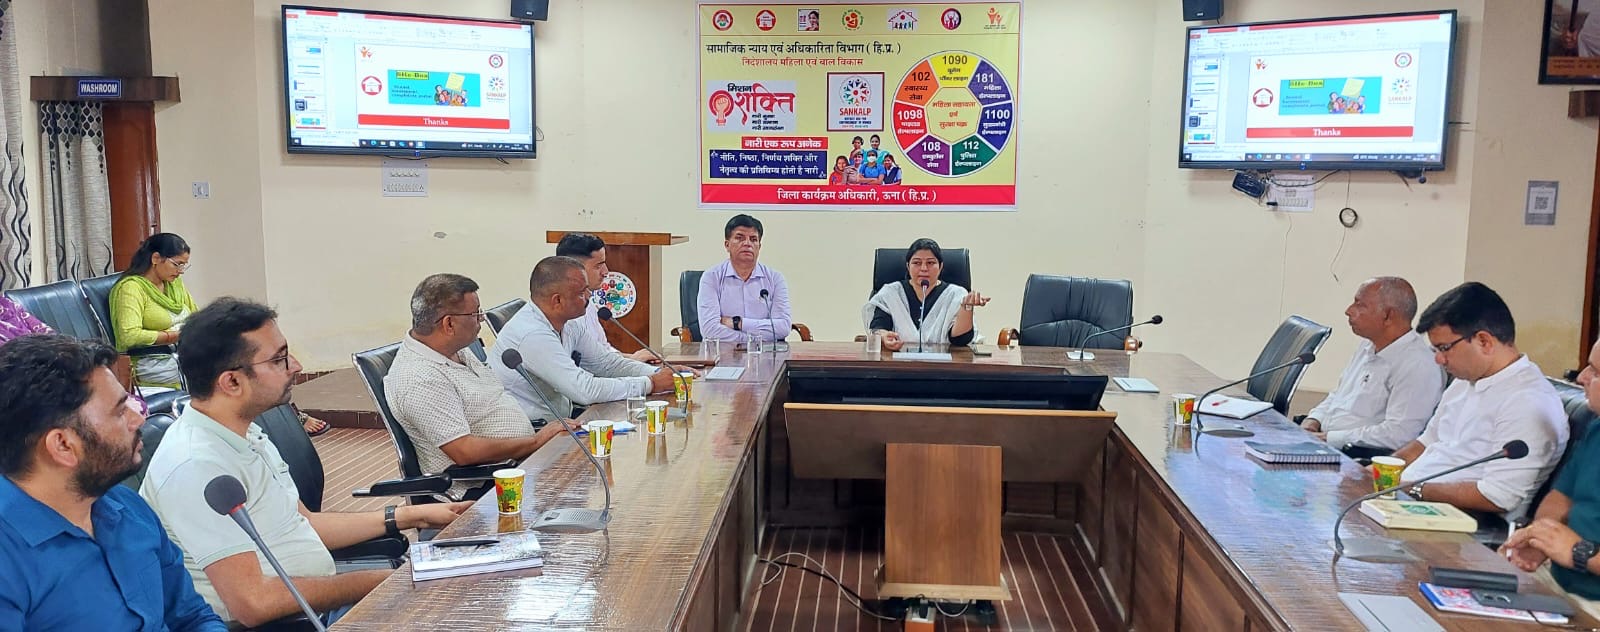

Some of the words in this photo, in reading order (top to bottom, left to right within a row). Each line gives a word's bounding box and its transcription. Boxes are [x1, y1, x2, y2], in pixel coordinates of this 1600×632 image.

[706, 42, 746, 54] सामाजिक
[749, 44, 768, 54] न्याय
[770, 42, 784, 56] एवं
[786, 42, 834, 54] अधिकारिता
[836, 42, 864, 54] विभाग
[780, 57, 804, 66] महिला
[806, 57, 817, 67] एवं
[819, 58, 834, 66] बाल
[838, 57, 864, 66] विकास
[942, 56, 968, 64] 1090
[912, 72, 930, 81] 102
[976, 73, 994, 82] 181
[81, 84, 117, 93] WASHROOM
[728, 83, 752, 92] मिशन
[734, 83, 796, 126] शक्ति
[840, 108, 872, 116] SANKALP
[897, 110, 923, 120] 1098
[985, 110, 1010, 119] 1100
[1312, 128, 1341, 136] Thanks
[744, 138, 762, 148] नारी
[797, 138, 821, 148] अनेक
[922, 142, 941, 151] 108
[963, 141, 979, 150] 112
[720, 152, 737, 162] नीति,
[762, 152, 781, 162] निर्णय
[783, 153, 802, 162] शक्ति
[804, 153, 818, 162] और
[719, 165, 737, 176] नेतृत्व
[739, 165, 749, 174] की
[781, 165, 796, 174] होती
[797, 165, 802, 175] है
[804, 166, 818, 174] नारी
[777, 188, 799, 200] जिला
[801, 188, 835, 200] कार्यक्रम
[838, 188, 879, 200] अधिकारी,
[882, 190, 900, 200] ऊना
